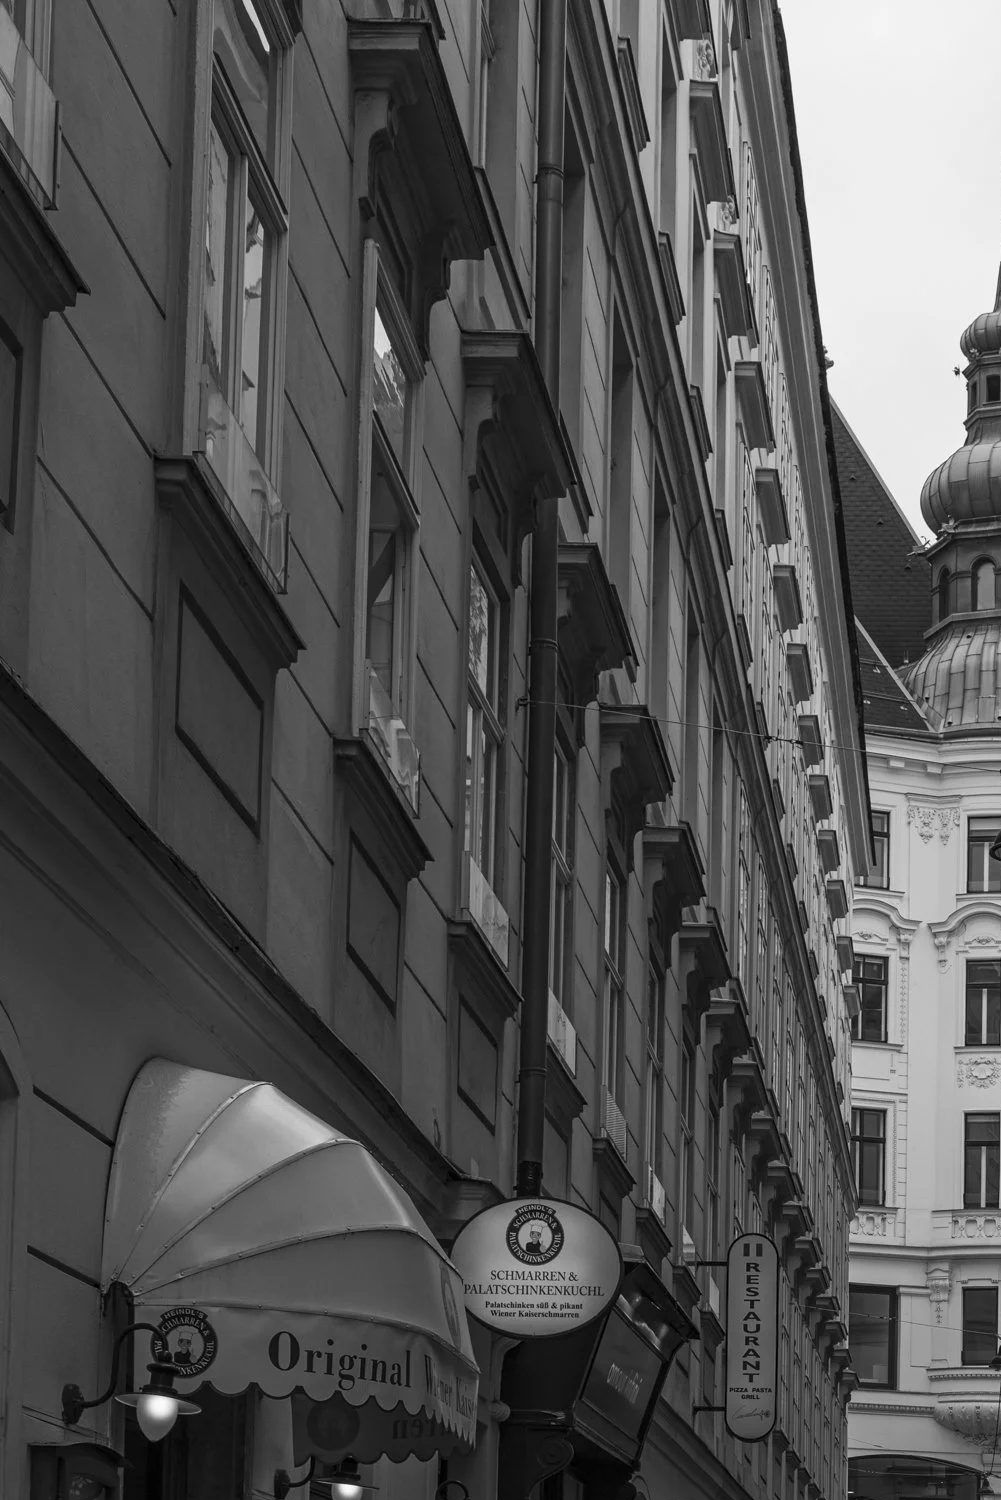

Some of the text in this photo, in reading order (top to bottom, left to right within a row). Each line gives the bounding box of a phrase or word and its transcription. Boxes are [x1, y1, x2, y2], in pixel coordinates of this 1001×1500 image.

[490, 1270, 579, 1282] SCHMARREN &
[464, 1284, 605, 1297] PALATSCHINKENKUCHL
[485, 1301, 535, 1309] Palatschinken
[536, 1301, 549, 1309] süß
[559, 1302, 583, 1311] pikant
[491, 1310, 580, 1319] Wiener Kaiserschmarren
[742, 1262, 762, 1383] RESTAURANT
[268, 1331, 412, 1391] Original
